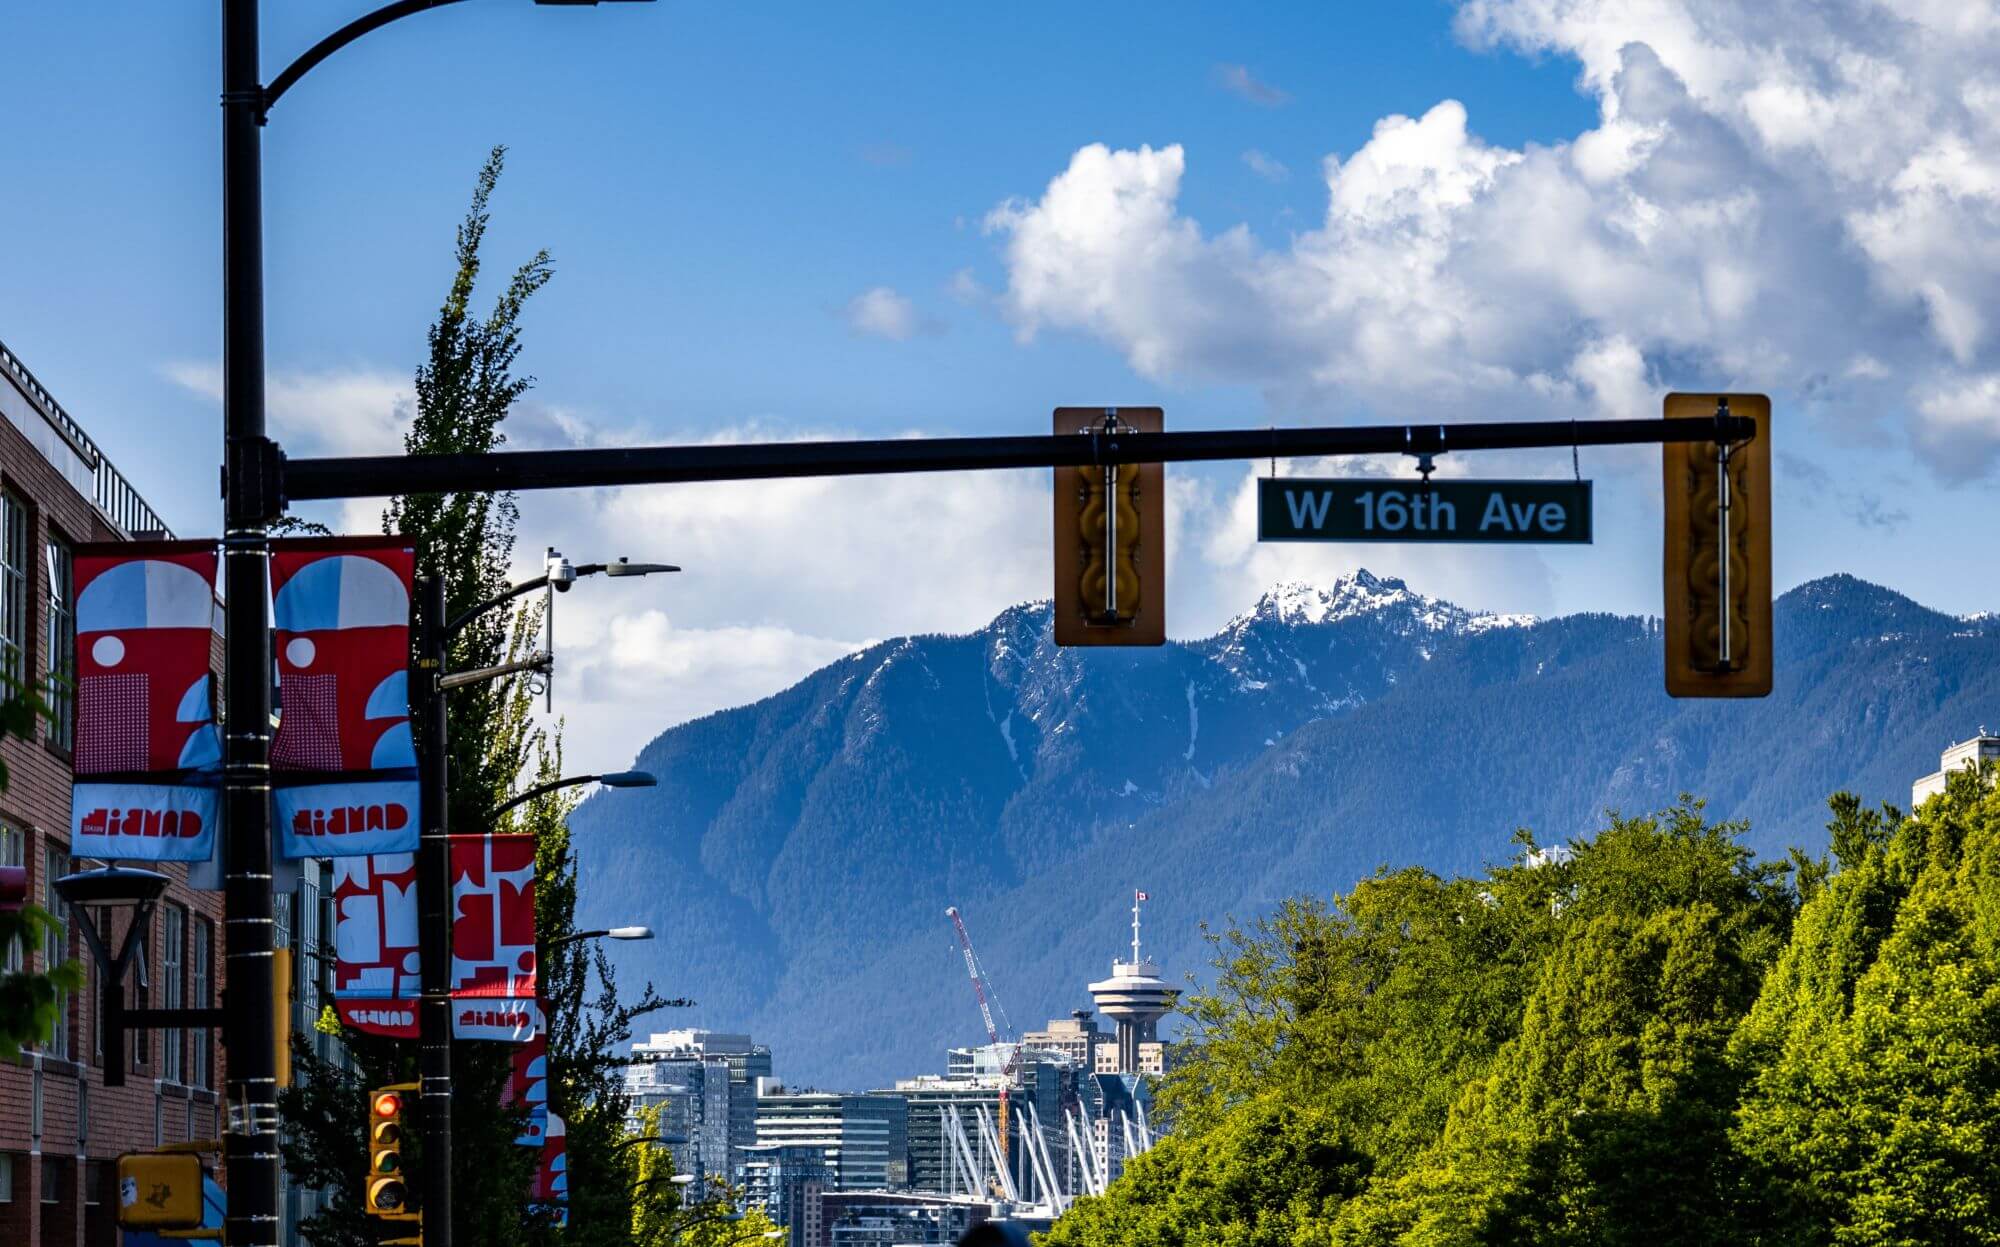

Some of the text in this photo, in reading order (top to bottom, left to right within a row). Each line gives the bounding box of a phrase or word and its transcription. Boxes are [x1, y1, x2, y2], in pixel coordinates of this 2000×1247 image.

[1284, 490, 1567, 532] W 16th Ave
